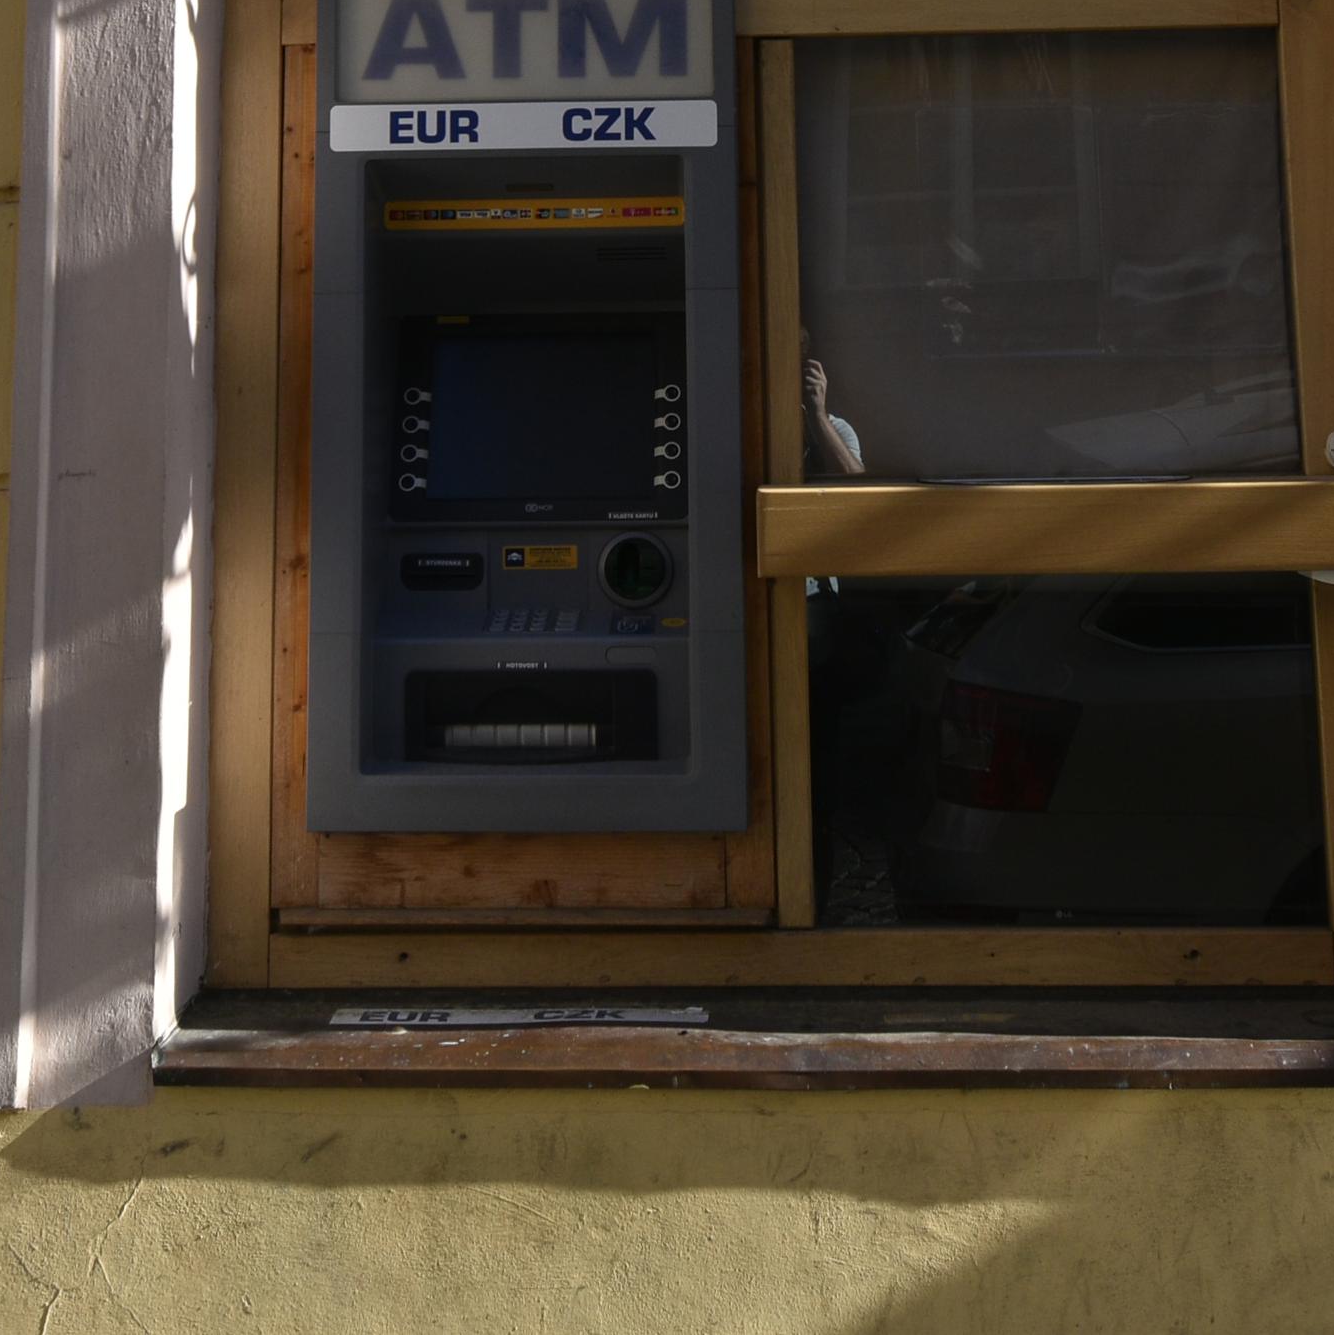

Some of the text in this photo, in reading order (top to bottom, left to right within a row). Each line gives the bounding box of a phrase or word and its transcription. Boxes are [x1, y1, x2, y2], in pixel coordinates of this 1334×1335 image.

[389, 107, 656, 144] EUR CZK
[358, 1009, 626, 1022] EUR CZK
